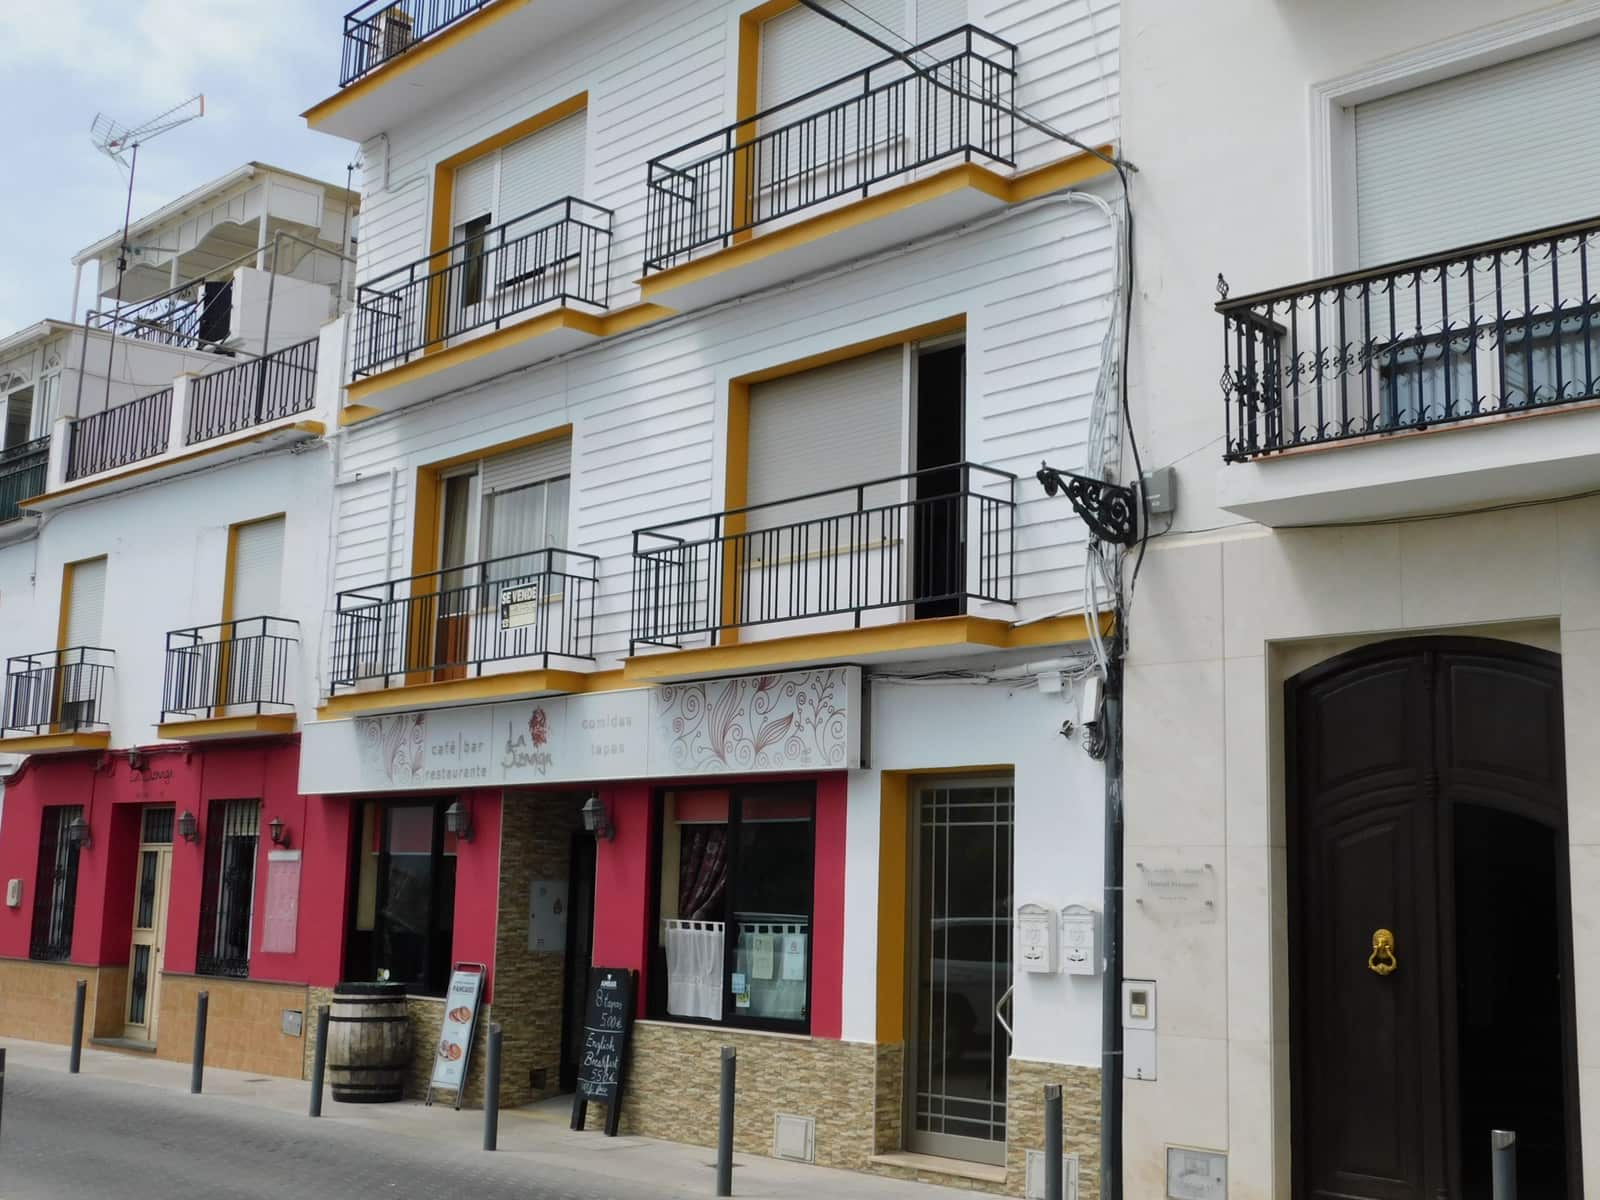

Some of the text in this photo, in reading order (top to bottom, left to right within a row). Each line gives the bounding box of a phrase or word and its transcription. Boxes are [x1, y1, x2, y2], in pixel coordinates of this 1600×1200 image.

[502, 587, 537, 604] SE VENDE
[424, 764, 488, 781] restaurante
[585, 1032, 615, 1056] English
